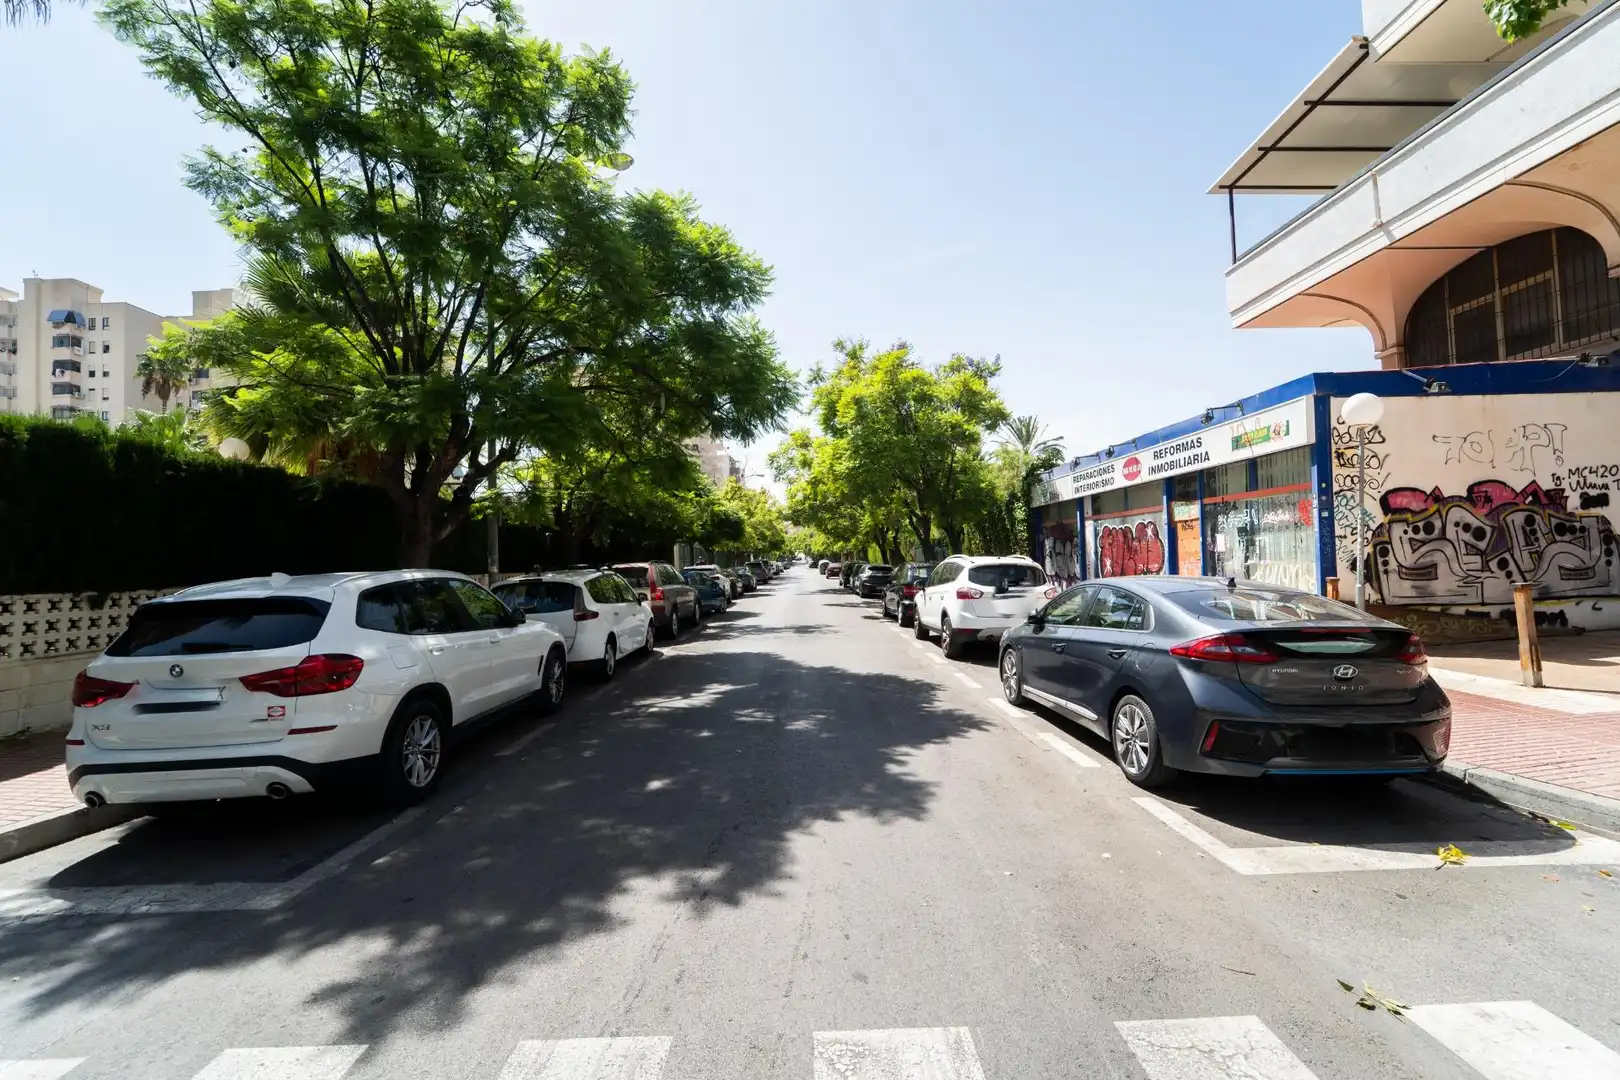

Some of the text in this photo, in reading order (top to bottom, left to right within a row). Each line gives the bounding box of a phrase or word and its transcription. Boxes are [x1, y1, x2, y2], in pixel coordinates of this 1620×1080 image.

[1153, 437, 1203, 461] REFORMAS
[1148, 451, 1210, 477] INMOBILIARIA
[1568, 464, 1619, 479] MC420
[1072, 464, 1115, 484] REPARACIONES
[1074, 478, 1115, 494] INTERIORISMO
[91, 723, 111, 732] X3
